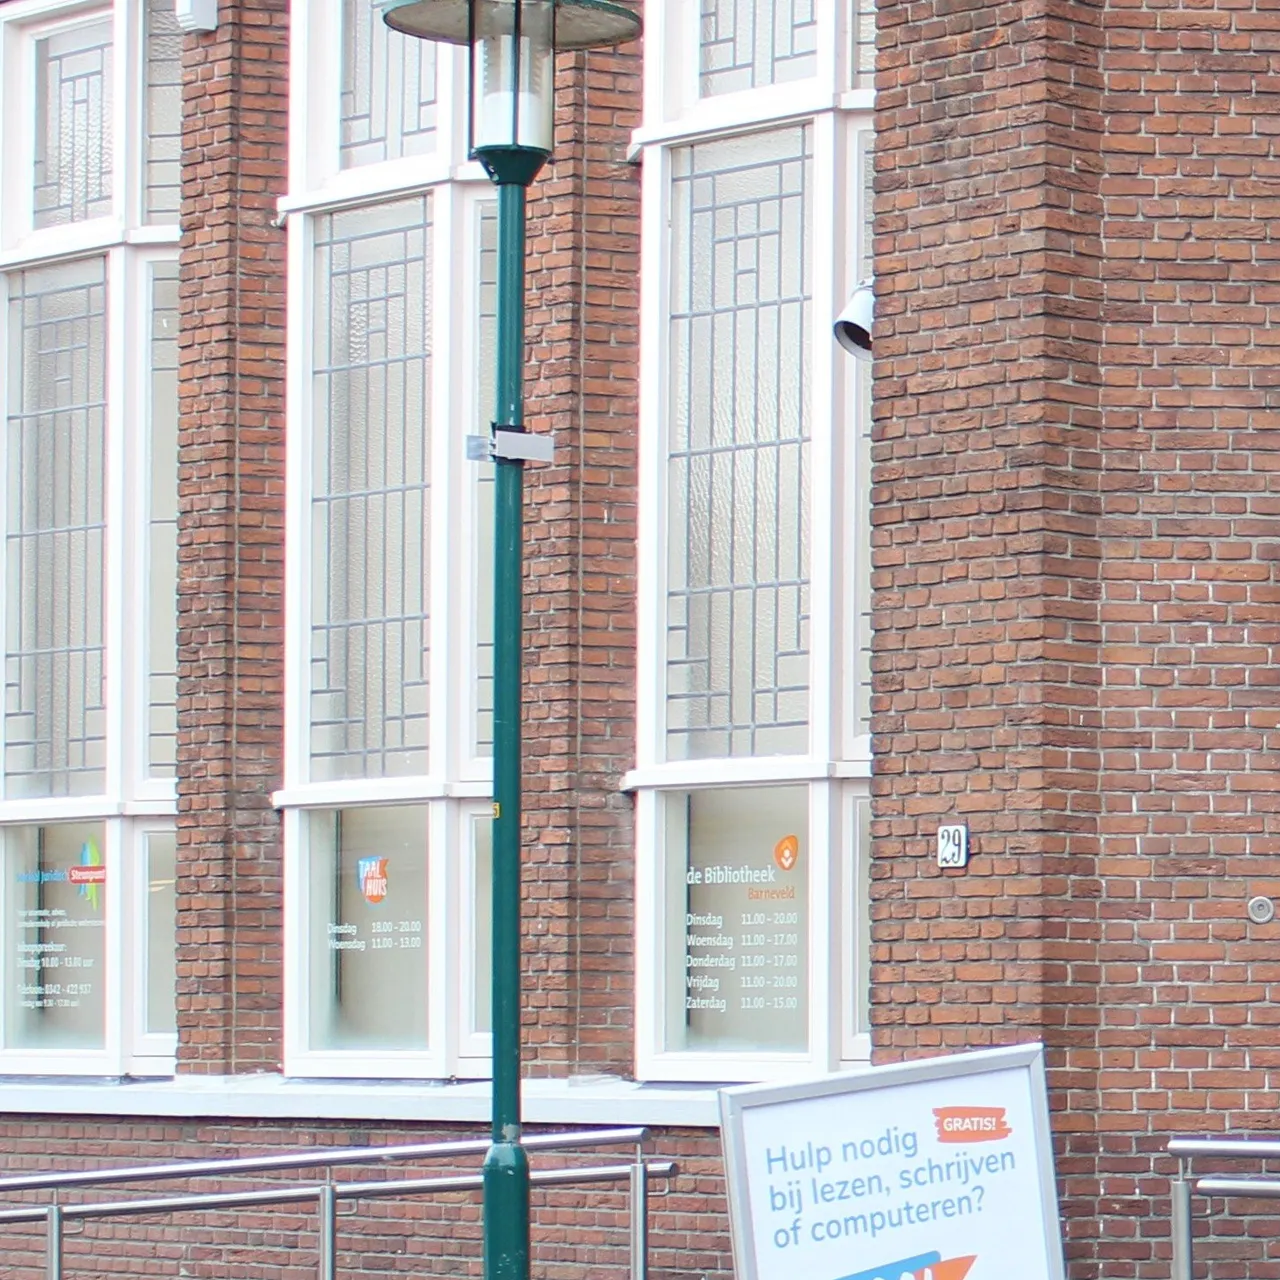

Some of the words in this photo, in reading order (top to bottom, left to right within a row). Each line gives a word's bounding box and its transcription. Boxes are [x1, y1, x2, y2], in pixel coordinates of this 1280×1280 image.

[941, 828, 961, 864] 29
[359, 860, 382, 879] TAAL
[687, 867, 702, 884] de
[705, 865, 775, 884] Bibliotheek
[366, 879, 387, 897] HUIS
[748, 886, 795, 900] Barneveld
[327, 922, 357, 935] Dinsdag
[687, 912, 723, 929] Dinsdag
[741, 913, 765, 925] 11.00
[328, 939, 366, 951] Woensdag
[687, 934, 734, 949] Woensdag
[741, 934, 765, 946] 11.00
[687, 954, 735, 970] Donderdag
[741, 955, 765, 967] 11.00
[687, 975, 720, 991] Vrijdag
[741, 976, 765, 988] 11.00
[687, 996, 726, 1012] Zaterdag
[741, 997, 765, 1009] 11.00
[943, 1117, 996, 1132] GRATIS!
[766, 1141, 832, 1174] Hulp
[842, 1126, 918, 1158] nodig
[770, 1181, 803, 1214] bij
[812, 1173, 891, 1204] lezen,
[900, 1151, 1015, 1189] schrijven
[774, 1218, 801, 1248] of
[811, 1185, 985, 1241] computeren?
